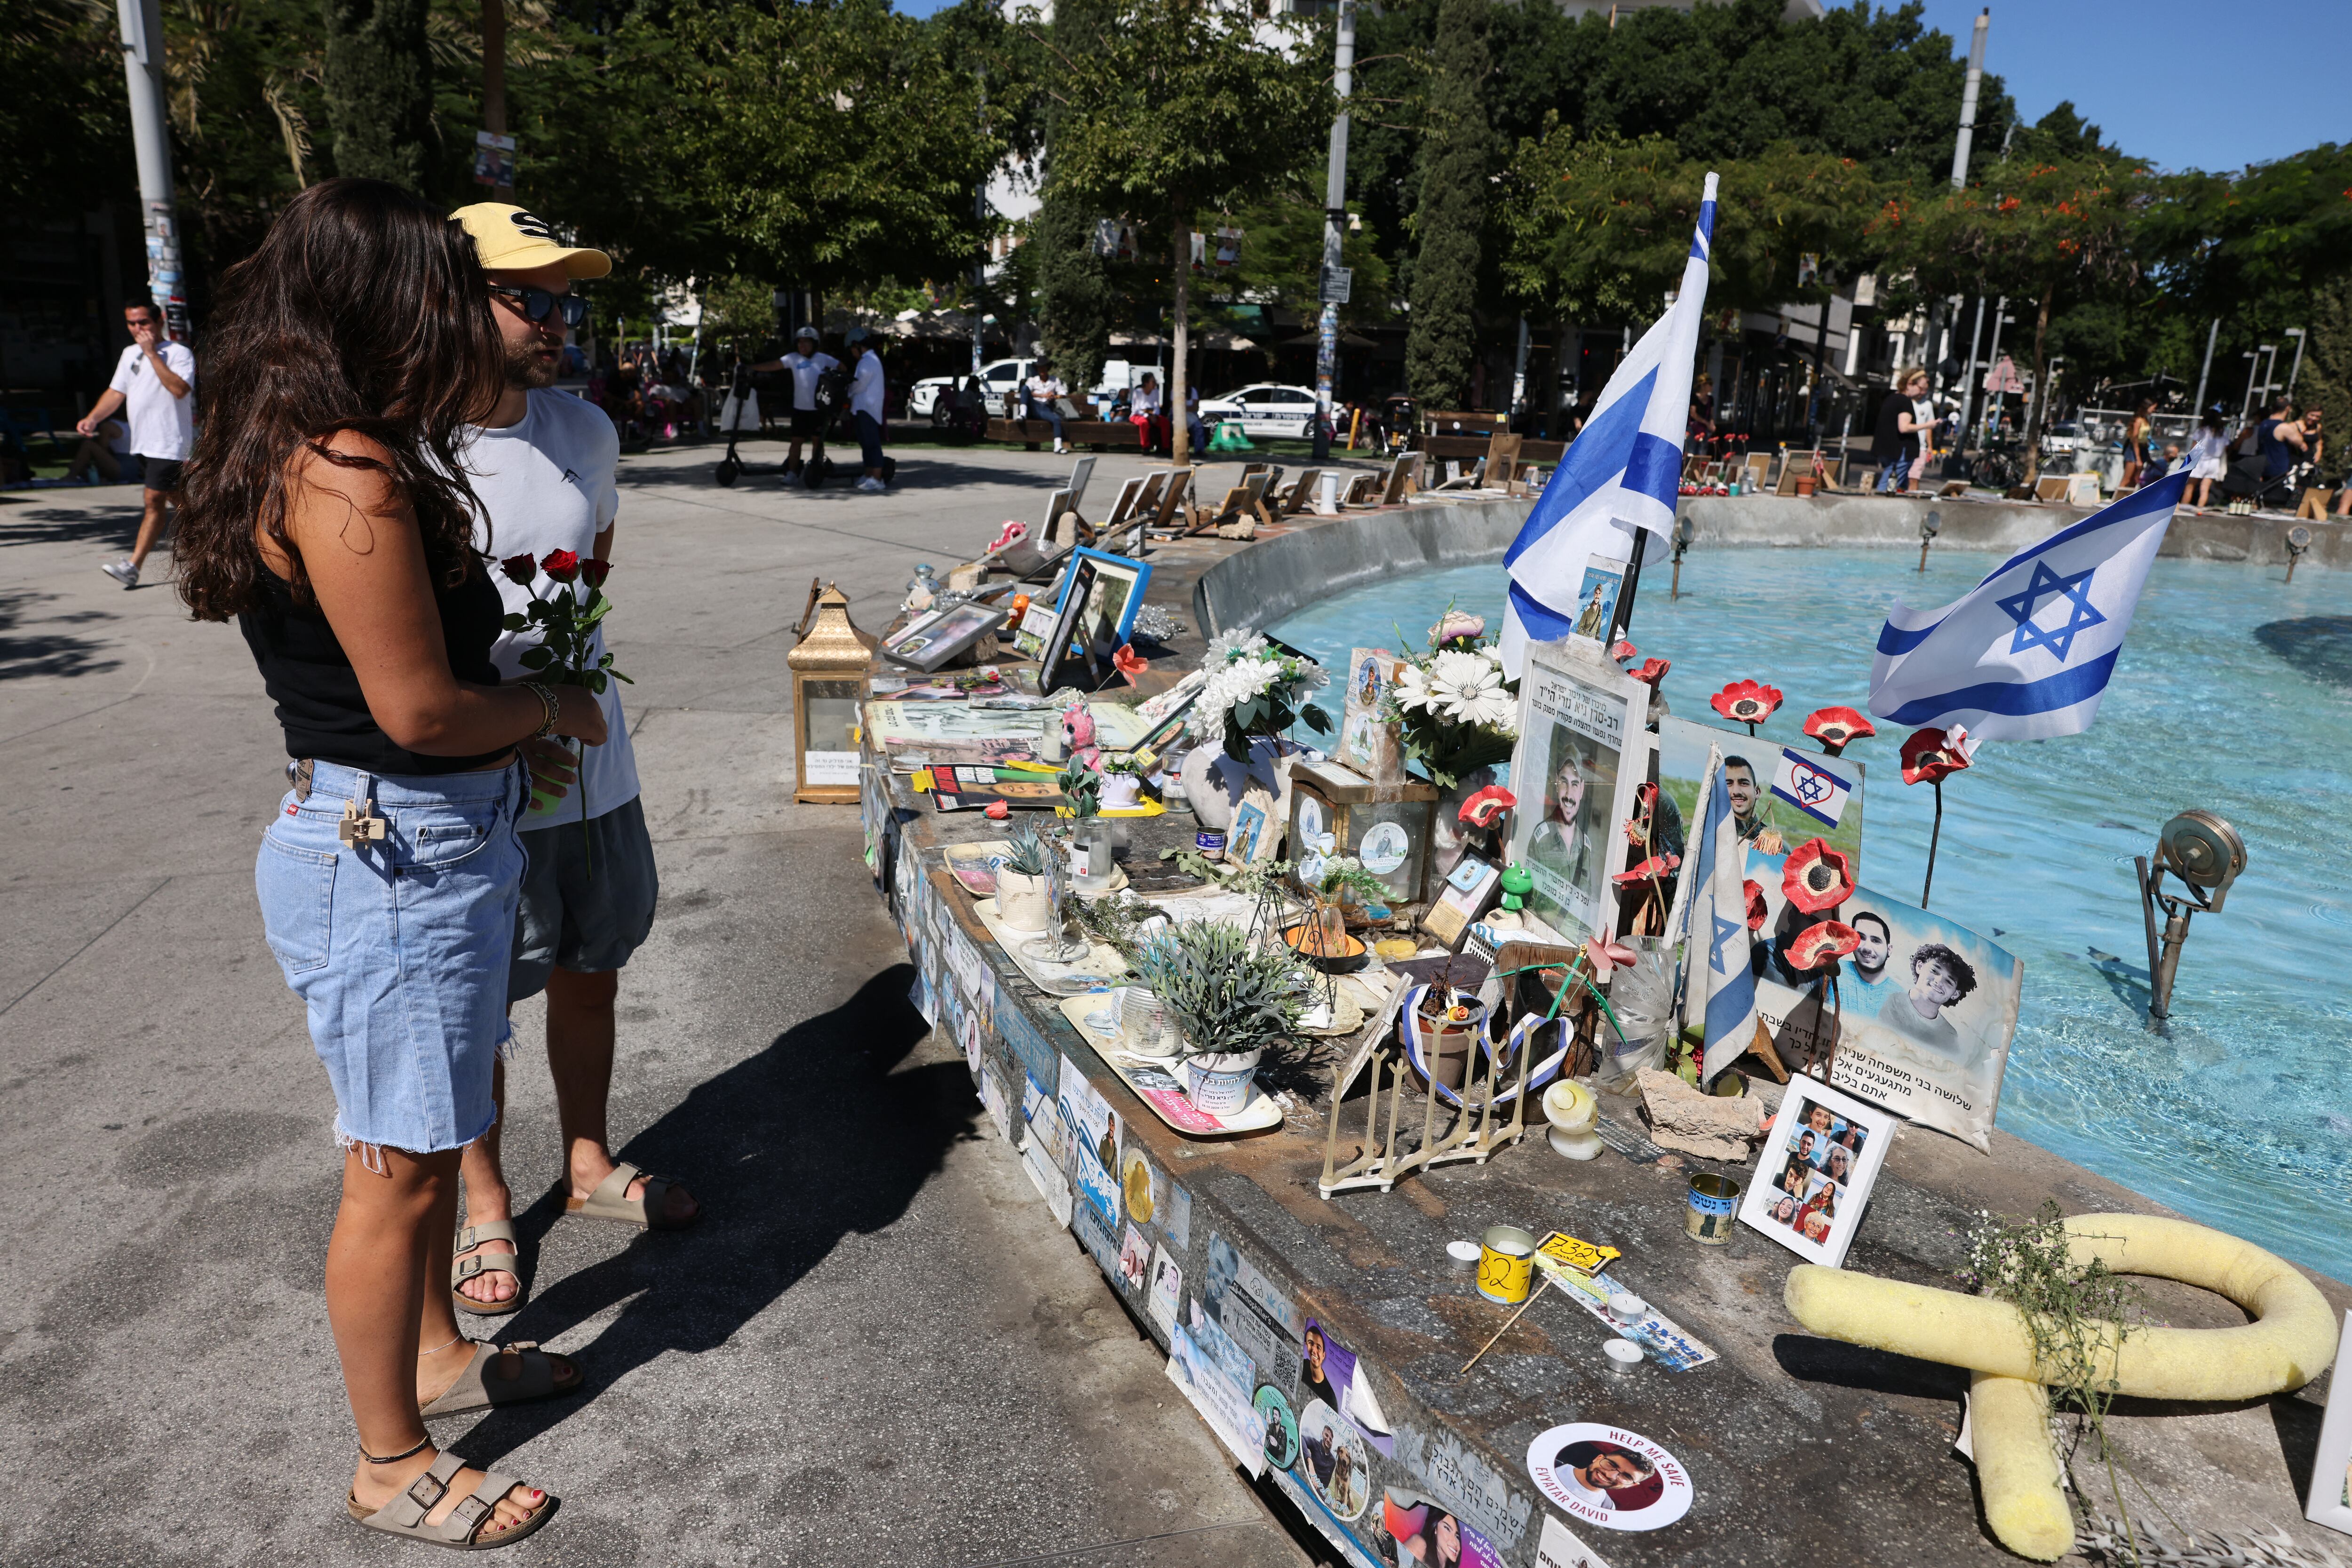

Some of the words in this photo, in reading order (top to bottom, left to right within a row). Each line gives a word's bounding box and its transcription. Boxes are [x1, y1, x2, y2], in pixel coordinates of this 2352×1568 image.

[1551, 680, 1566, 693] ישראל
[1568, 689, 1581, 699] גיבור
[1582, 693, 1590, 704] של
[1532, 699, 1542, 709] בוער
[1558, 694, 1571, 709] נזרי
[1574, 701, 1587, 716] גיא
[1592, 699, 1606, 712] לזיכרו
[1543, 704, 1555, 716] מטנק
[1557, 710, 1572, 724] פקודיו
[1573, 718, 1590, 732] בהצלת
[1590, 708, 1618, 731] רב-סרן
[1593, 727, 1605, 739] נפשו
[1607, 733, 1622, 747] שחרף
[933, 767, 954, 781] HOME
[955, 767, 977, 781] HER
[975, 767, 997, 783] BRING
[938, 779, 962, 793] NOW!
[1526, 859, 1547, 877] התשפ"ה
[1549, 873, 1564, 888] בתשרי
[1542, 882, 1557, 897] בנופלו
[1558, 892, 1564, 901] 25
[1565, 897, 1570, 906] בן
[1581, 893, 1589, 906] נפל
[1762, 1012, 1791, 1032] בשבת
[1789, 1037, 1801, 1049] כך
[1822, 1038, 1866, 1062] שנירחו
[1820, 1051, 1852, 1071] אלים
[1242, 1069, 1253, 1081] טוב
[1868, 1057, 1912, 1082] משפחה
[1200, 1076, 1215, 1085] בעד
[1217, 1076, 1240, 1086] לחיות
[1824, 1068, 1858, 1089] בליבו
[1855, 1067, 1912, 1096] מתגעגעים
[1915, 1076, 1931, 1091] בני
[1072, 1083, 1084, 1102] ארצנו
[1861, 1084, 1888, 1101] אתם
[1933, 1085, 1972, 1111] שלושה
[1085, 1097, 1094, 1113] בעד
[1097, 1101, 1105, 1114] טוב
[1175, 1097, 1196, 1112] לחיות
[1094, 1108, 1106, 1126] לחיות
[1180, 1114, 1194, 1124] בעד
[1690, 1189, 1716, 1210] נשמה
[1721, 1201, 1731, 1210] נר
[1550, 1236, 1594, 1260] 732
[1238, 1289, 1271, 1325] Audiophiller's
[1272, 1320, 1283, 1336] Last
[1248, 1313, 1255, 1323] מה
[1247, 1319, 1255, 1333] אותך
[1255, 1319, 1261, 1329] את
[1256, 1329, 1270, 1346] שעושה
[1262, 1327, 1271, 1339] עשה
[1224, 1360, 1233, 1370] אותה
[1213, 1375, 1222, 1389] הכי
[1234, 1370, 1245, 1384] ומראה
[1200, 1373, 1217, 1397] ומעבר!
[1218, 1394, 1229, 1409] קצת
[1223, 1385, 1237, 1405] עושים
[1210, 1396, 1219, 1412] ארץ
[1255, 1402, 1265, 1414] לוחם
[1325, 1405, 1343, 1426] אריאל
[1235, 1425, 1240, 1435] כי
[1344, 1424, 1352, 1435] דן
[1609, 1431, 1644, 1447] HELP
[1645, 1448, 1666, 1462] ME
[1661, 1463, 1685, 1487] SAVE
[1468, 1477, 1482, 1497] הם
[1535, 1467, 1569, 1503] EVYATAR
[1569, 1501, 1608, 1521] DAVID
[1461, 1487, 1480, 1509] דרך
[1495, 1516, 1514, 1539] דרך
[1470, 1541, 1483, 1553] לנצח
